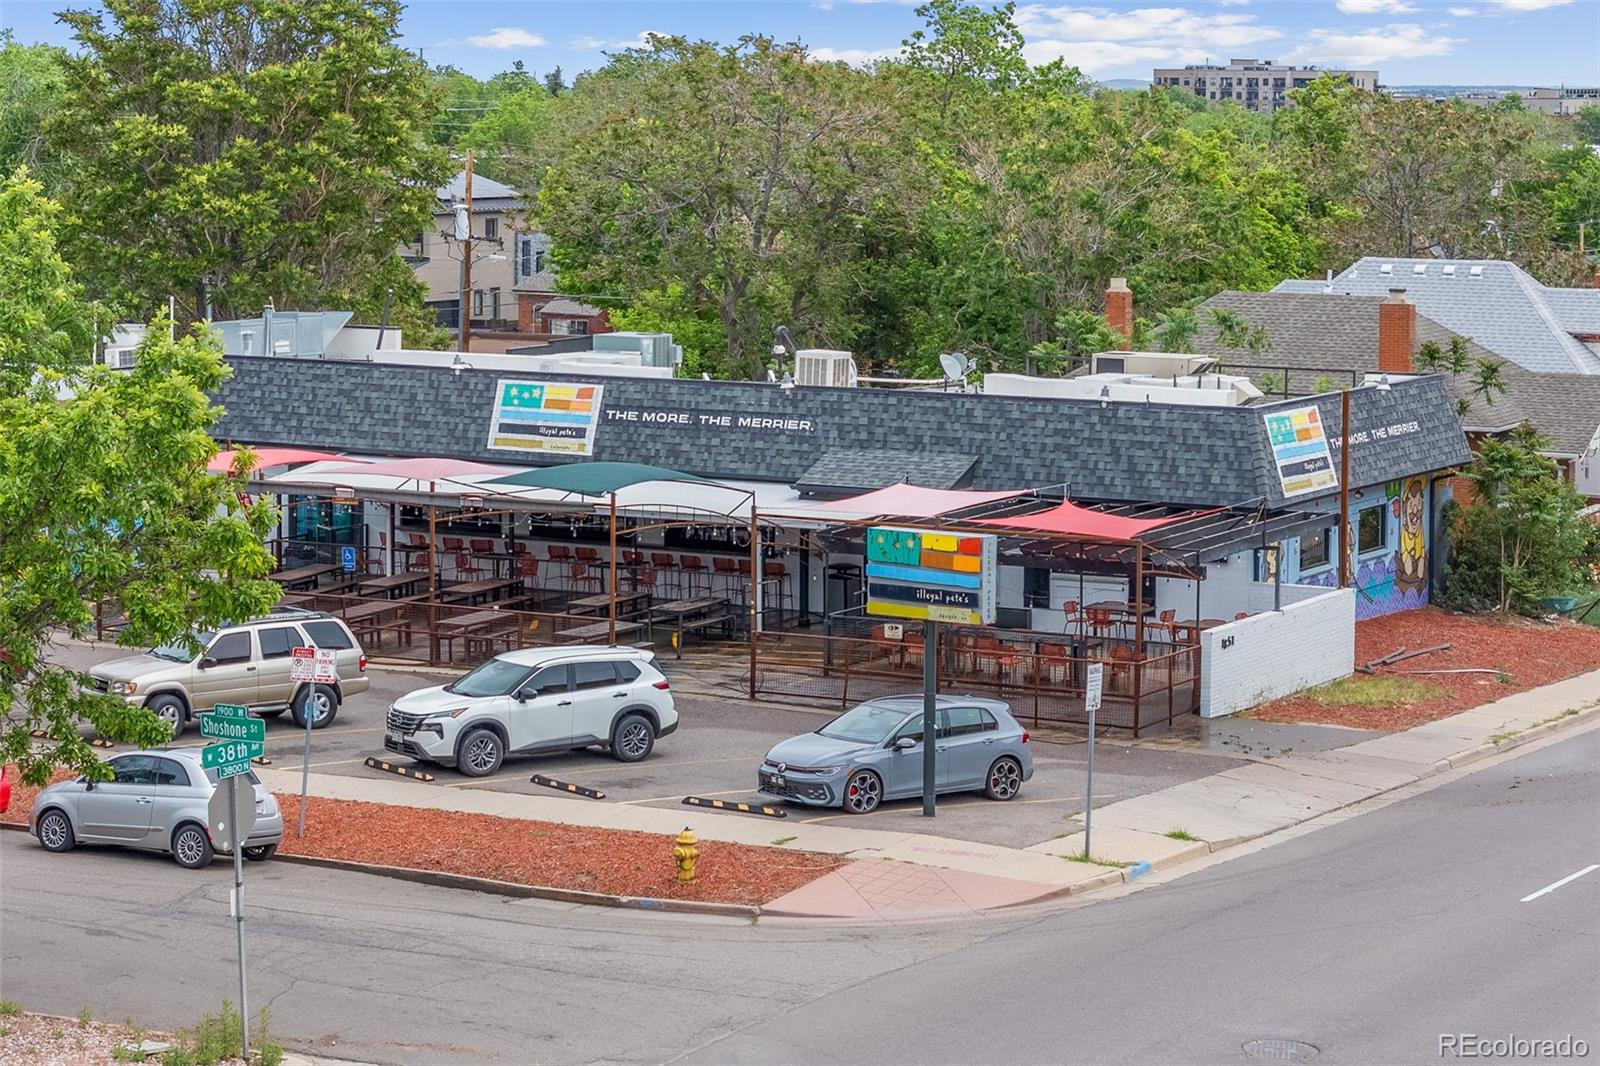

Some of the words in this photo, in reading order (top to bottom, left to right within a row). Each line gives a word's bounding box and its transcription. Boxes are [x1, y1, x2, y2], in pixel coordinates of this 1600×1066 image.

[606, 409, 639, 421] THE
[642, 411, 693, 424] MORE.
[699, 415, 731, 427] THE
[738, 417, 815, 432] MERRIER.
[1371, 428, 1387, 439] THE
[916, 588, 943, 603] illegal
[945, 592, 969, 604] pete's
[217, 706, 233, 716] 1900
[238, 708, 245, 717] W
[203, 717, 247, 738] Shoshone
[206, 752, 213, 762] W
[217, 743, 248, 763] 38th
[222, 763, 243, 776] 3800
[243, 762, 250, 771] N
